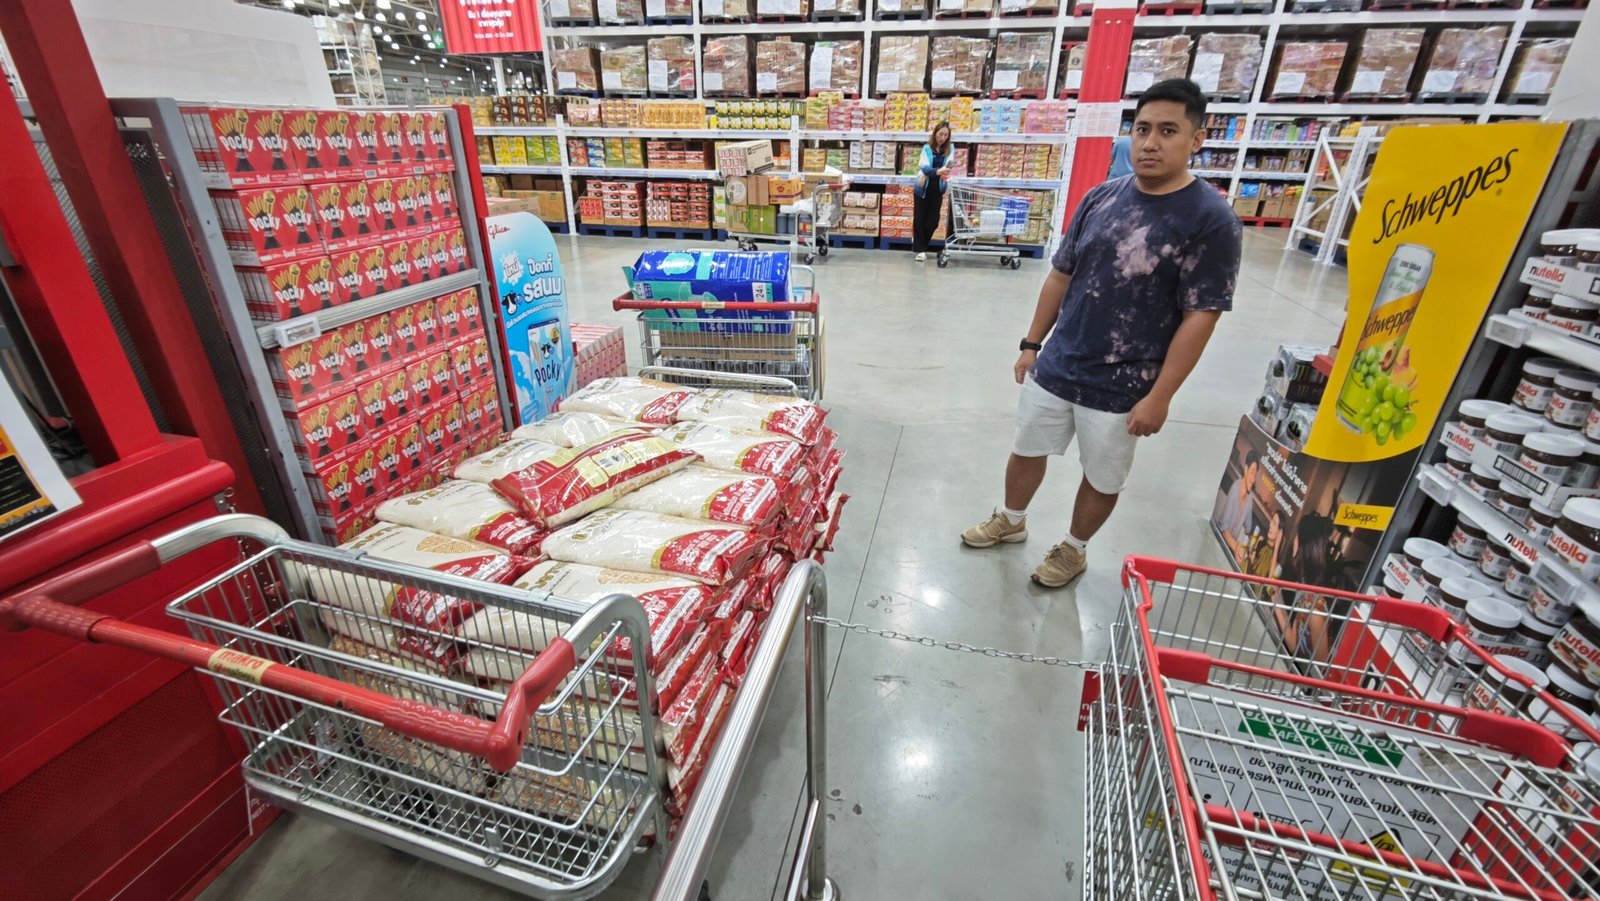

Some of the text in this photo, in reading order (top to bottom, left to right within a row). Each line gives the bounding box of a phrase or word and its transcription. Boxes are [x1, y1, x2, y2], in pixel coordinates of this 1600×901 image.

[1373, 149, 1519, 243] Schweppes
[488, 225, 510, 239] Glico
[1530, 266, 1565, 282] nutella
[523, 277, 562, 303] รสนม
[1446, 431, 1474, 451] nutella
[1343, 509, 1377, 524] Schweppes
[1388, 562, 1410, 585] nutella
[1268, 729, 1368, 759] SAFETY FIRST
